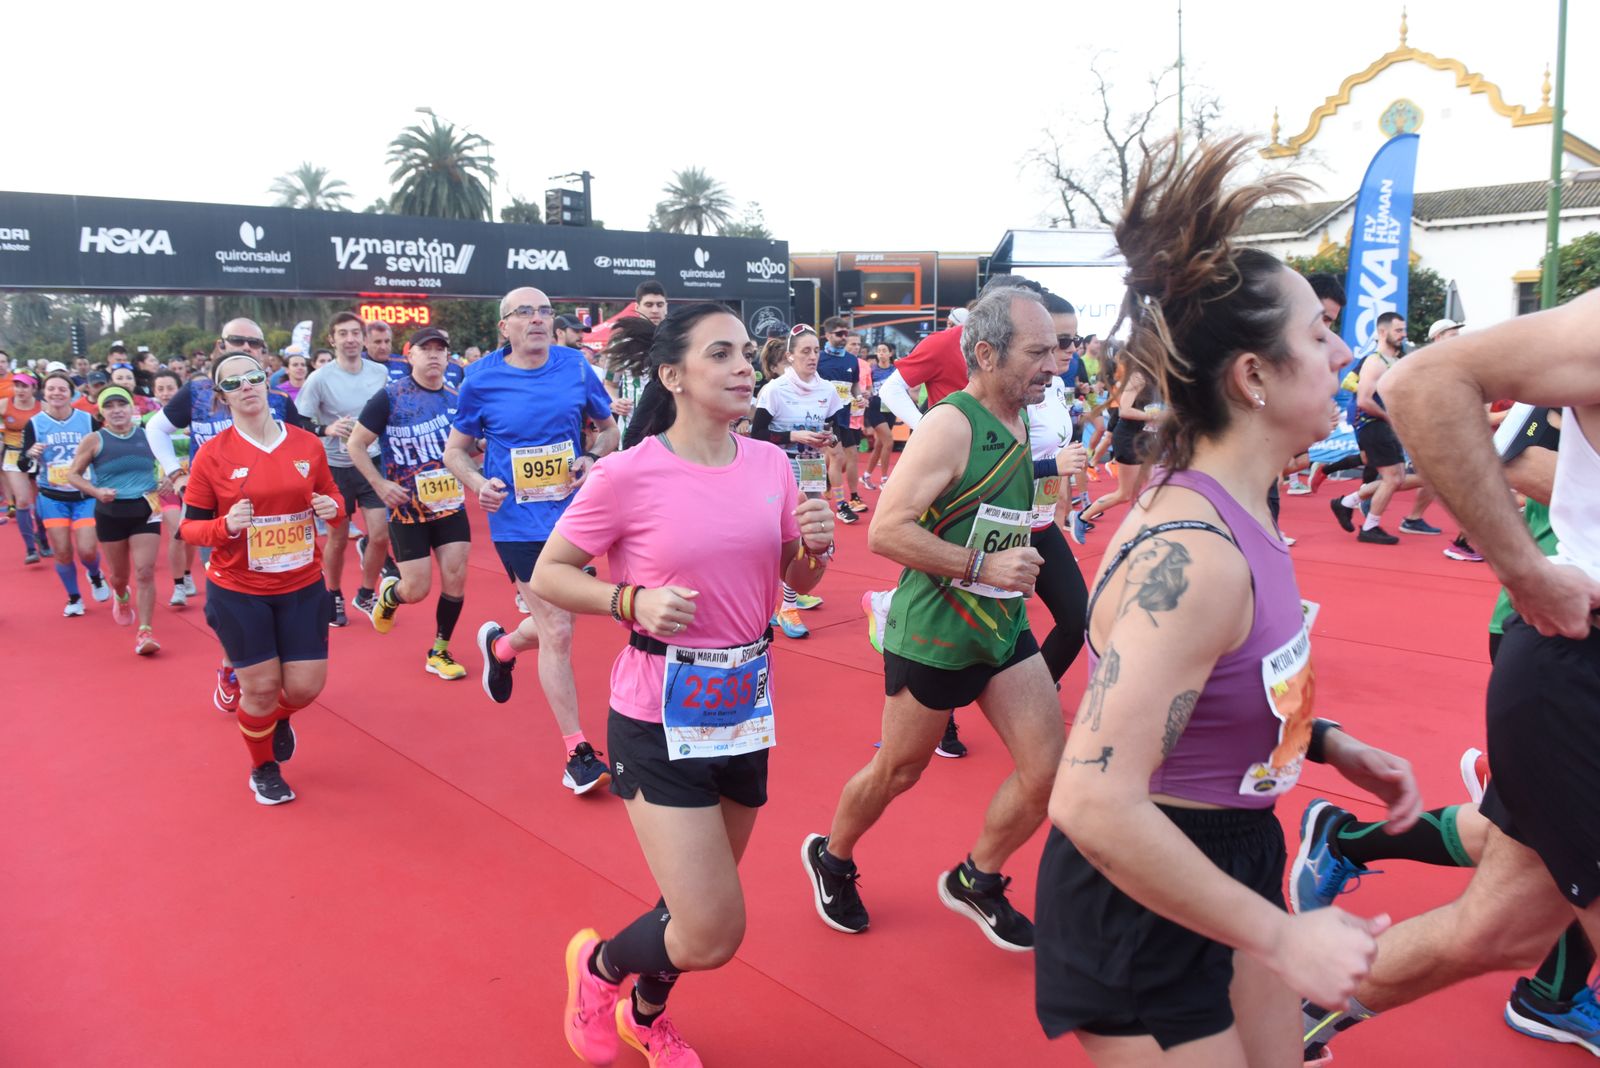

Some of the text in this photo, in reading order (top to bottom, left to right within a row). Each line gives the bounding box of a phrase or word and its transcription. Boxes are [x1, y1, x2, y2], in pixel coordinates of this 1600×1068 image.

[1375, 179, 1393, 243] HUMAN
[1363, 213, 1376, 241] FLY
[1386, 217, 1401, 244] FLY
[79, 226, 175, 256] HOKA
[360, 237, 455, 258] maratón
[222, 265, 285, 274] Healthcare Partner
[385, 255, 459, 274] sevilla
[506, 248, 570, 271] HOKA
[613, 258, 656, 268] HYUNDAI
[374, 276, 442, 288] 28 enero 2024
[360, 304, 430, 324] 00:03:43
[1353, 247, 1400, 360] OKA
[386, 414, 449, 438] MEDIO MARATÓN
[47, 431, 82, 445] NORTH
[523, 457, 563, 479] 9957
[421, 477, 456, 495] 13117
[254, 525, 304, 548] 12050
[697, 651, 729, 663] MARATÓN
[682, 672, 753, 709] 2535
